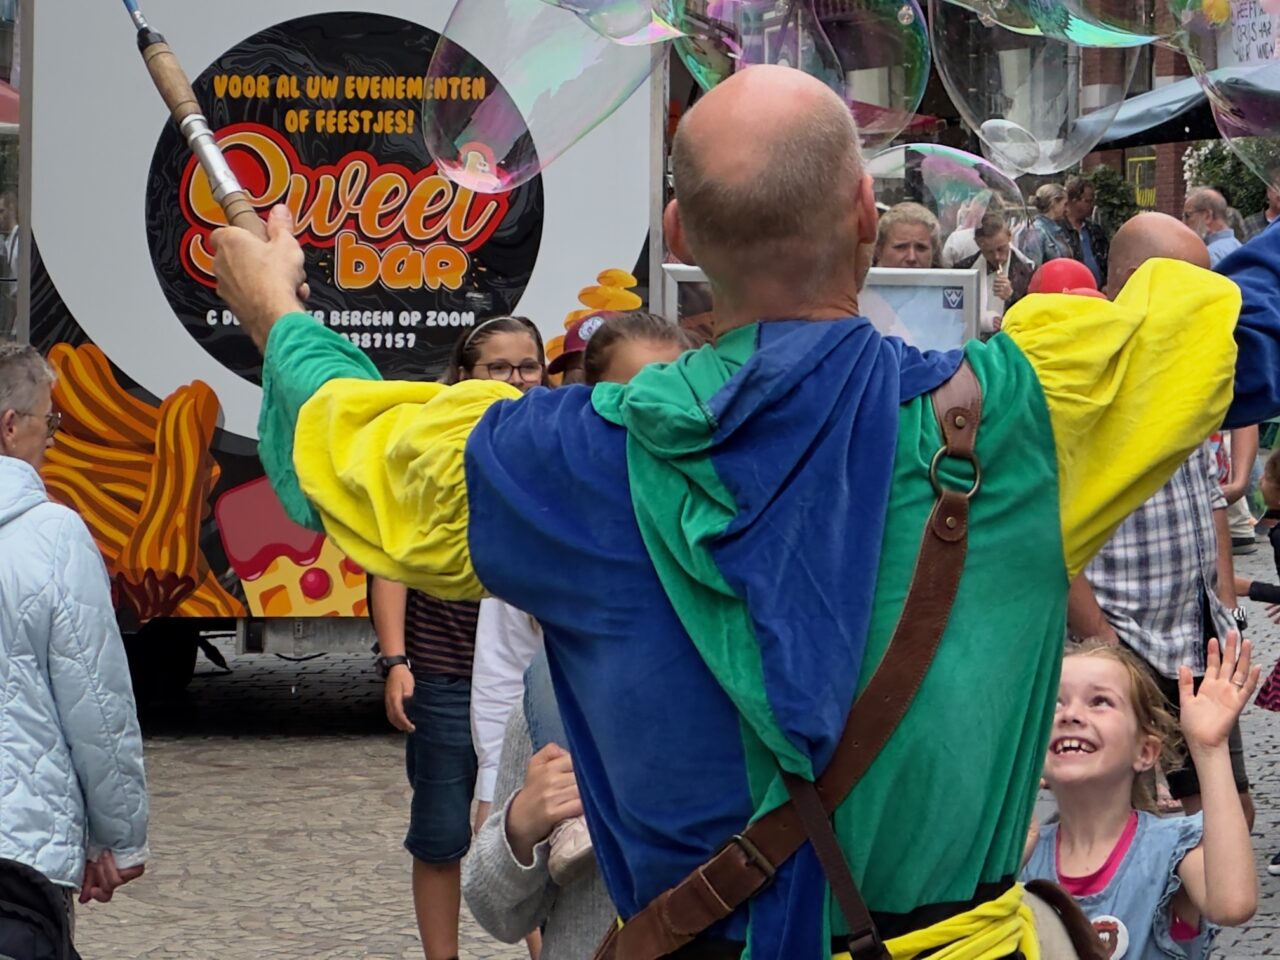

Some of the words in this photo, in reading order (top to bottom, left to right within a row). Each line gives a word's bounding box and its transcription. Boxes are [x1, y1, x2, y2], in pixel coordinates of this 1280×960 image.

[214, 74, 270, 99] VOOR
[276, 75, 300, 99] AL
[306, 76, 338, 100] UW
[345, 76, 486, 100] EVENEMENTEN
[285, 109, 309, 133] OF
[315, 110, 414, 134] FEESTJES!
[206, 309, 217, 325] C
[330, 311, 393, 327] BERGEN
[399, 311, 421, 326] OP
[426, 311, 475, 327] ZOOM
